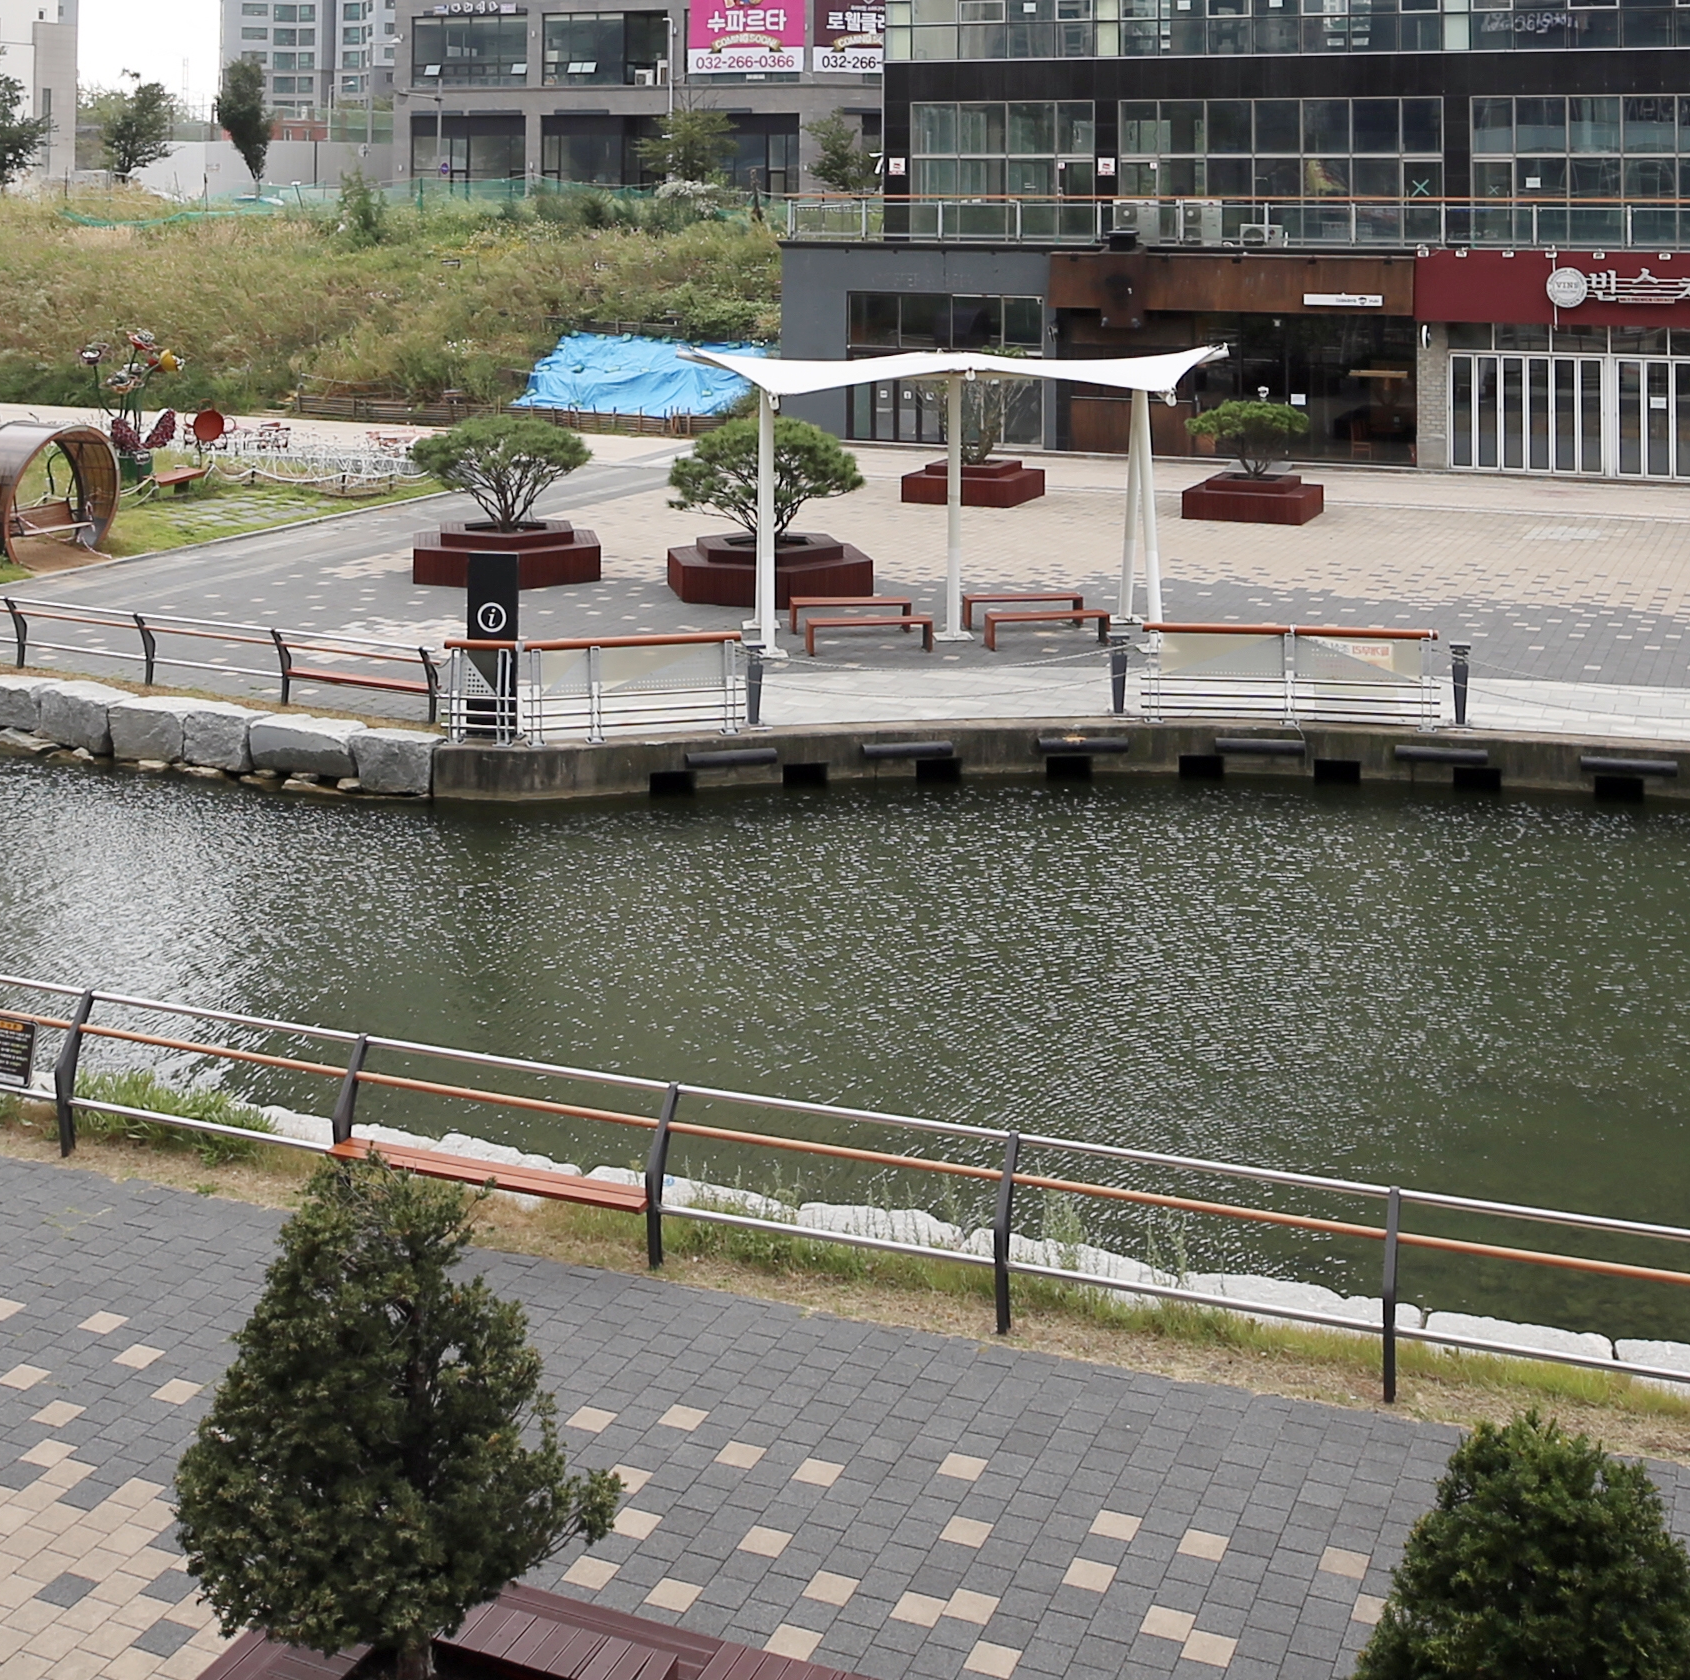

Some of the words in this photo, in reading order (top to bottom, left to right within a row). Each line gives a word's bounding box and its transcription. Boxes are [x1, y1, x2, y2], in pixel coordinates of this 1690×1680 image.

[707, 8, 787, 33] 수파르타
[714, 33, 749, 48] COMING
[696, 55, 795, 69] 032-266-0366
